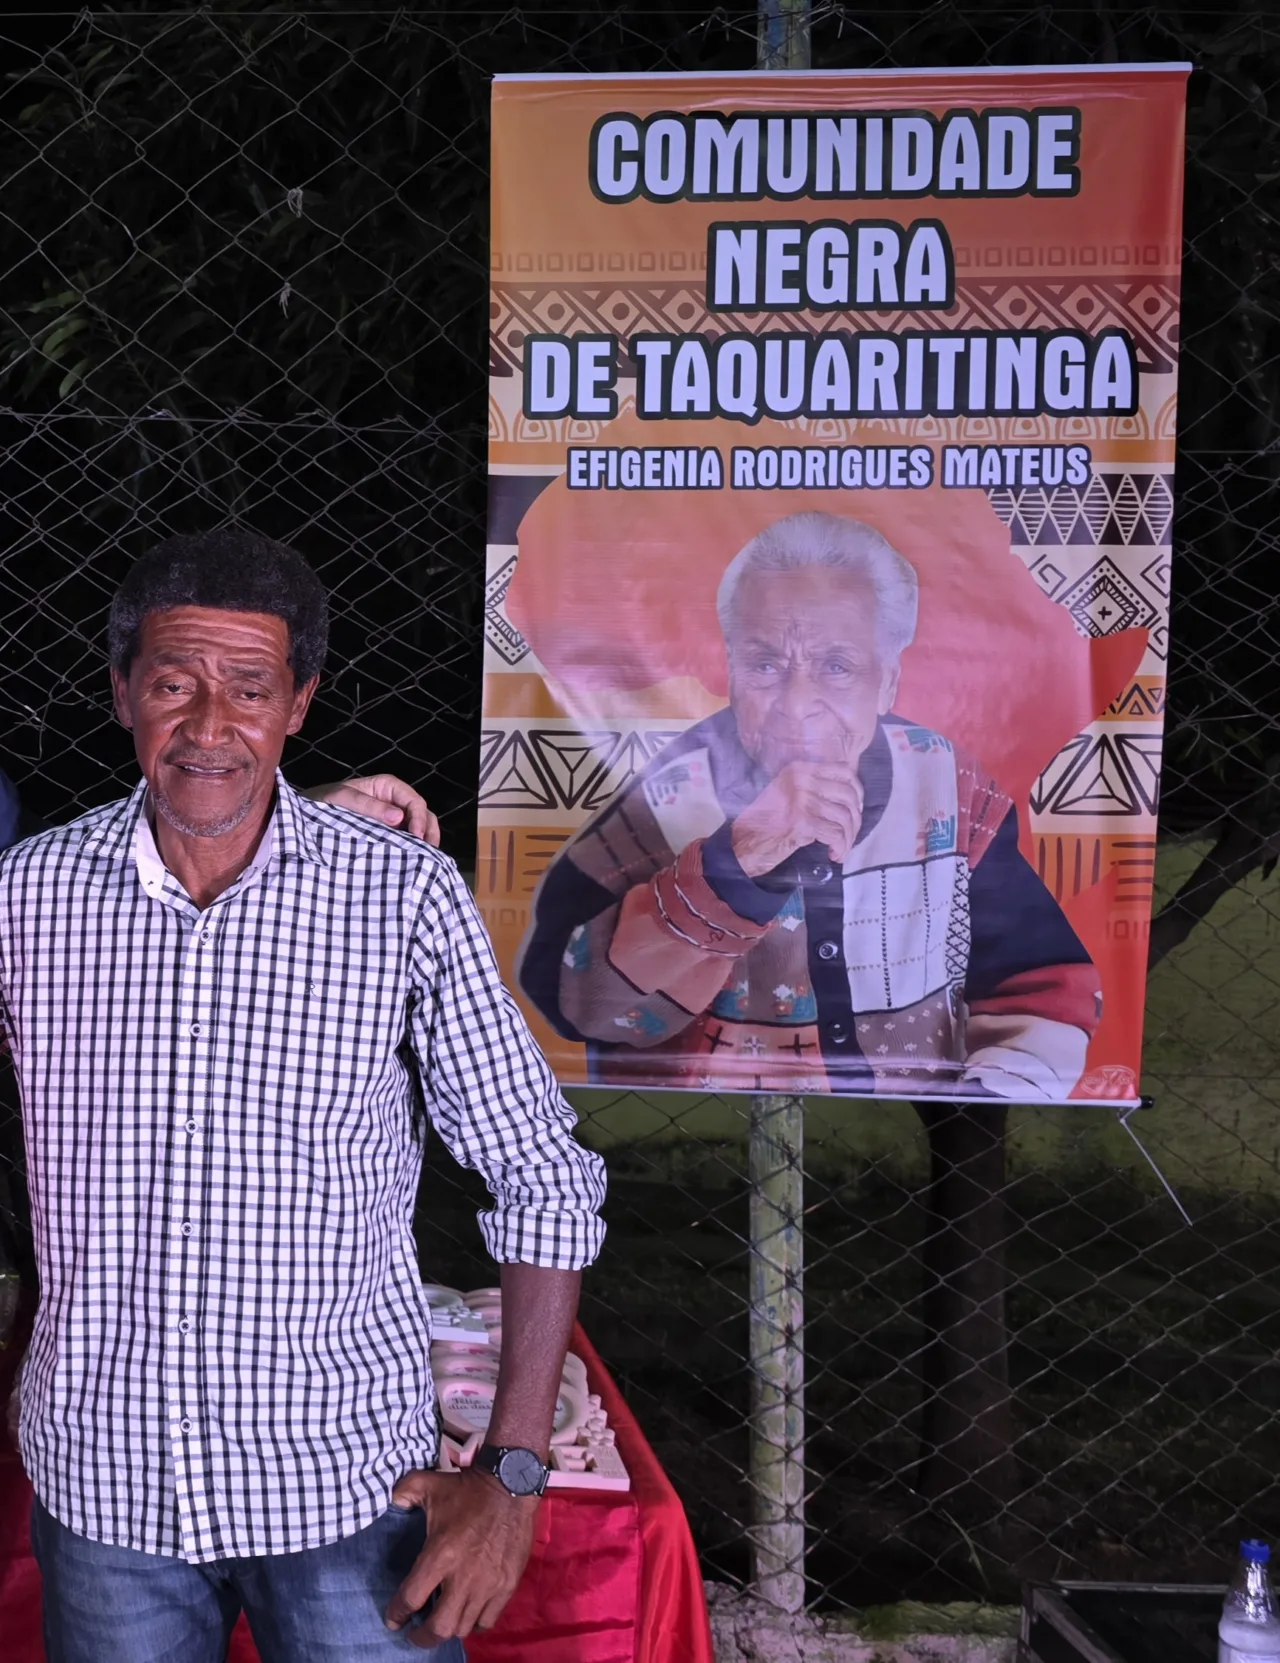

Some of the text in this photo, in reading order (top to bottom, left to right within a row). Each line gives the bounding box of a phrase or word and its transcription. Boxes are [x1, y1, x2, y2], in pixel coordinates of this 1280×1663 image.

[594, 113, 1076, 198] COMUNIDADE
[713, 226, 948, 306] NEGRA
[528, 335, 1133, 419] DE TAQUARITINGA
[569, 446, 1089, 488] EFIGENIA RODRIGUES MATEUS
